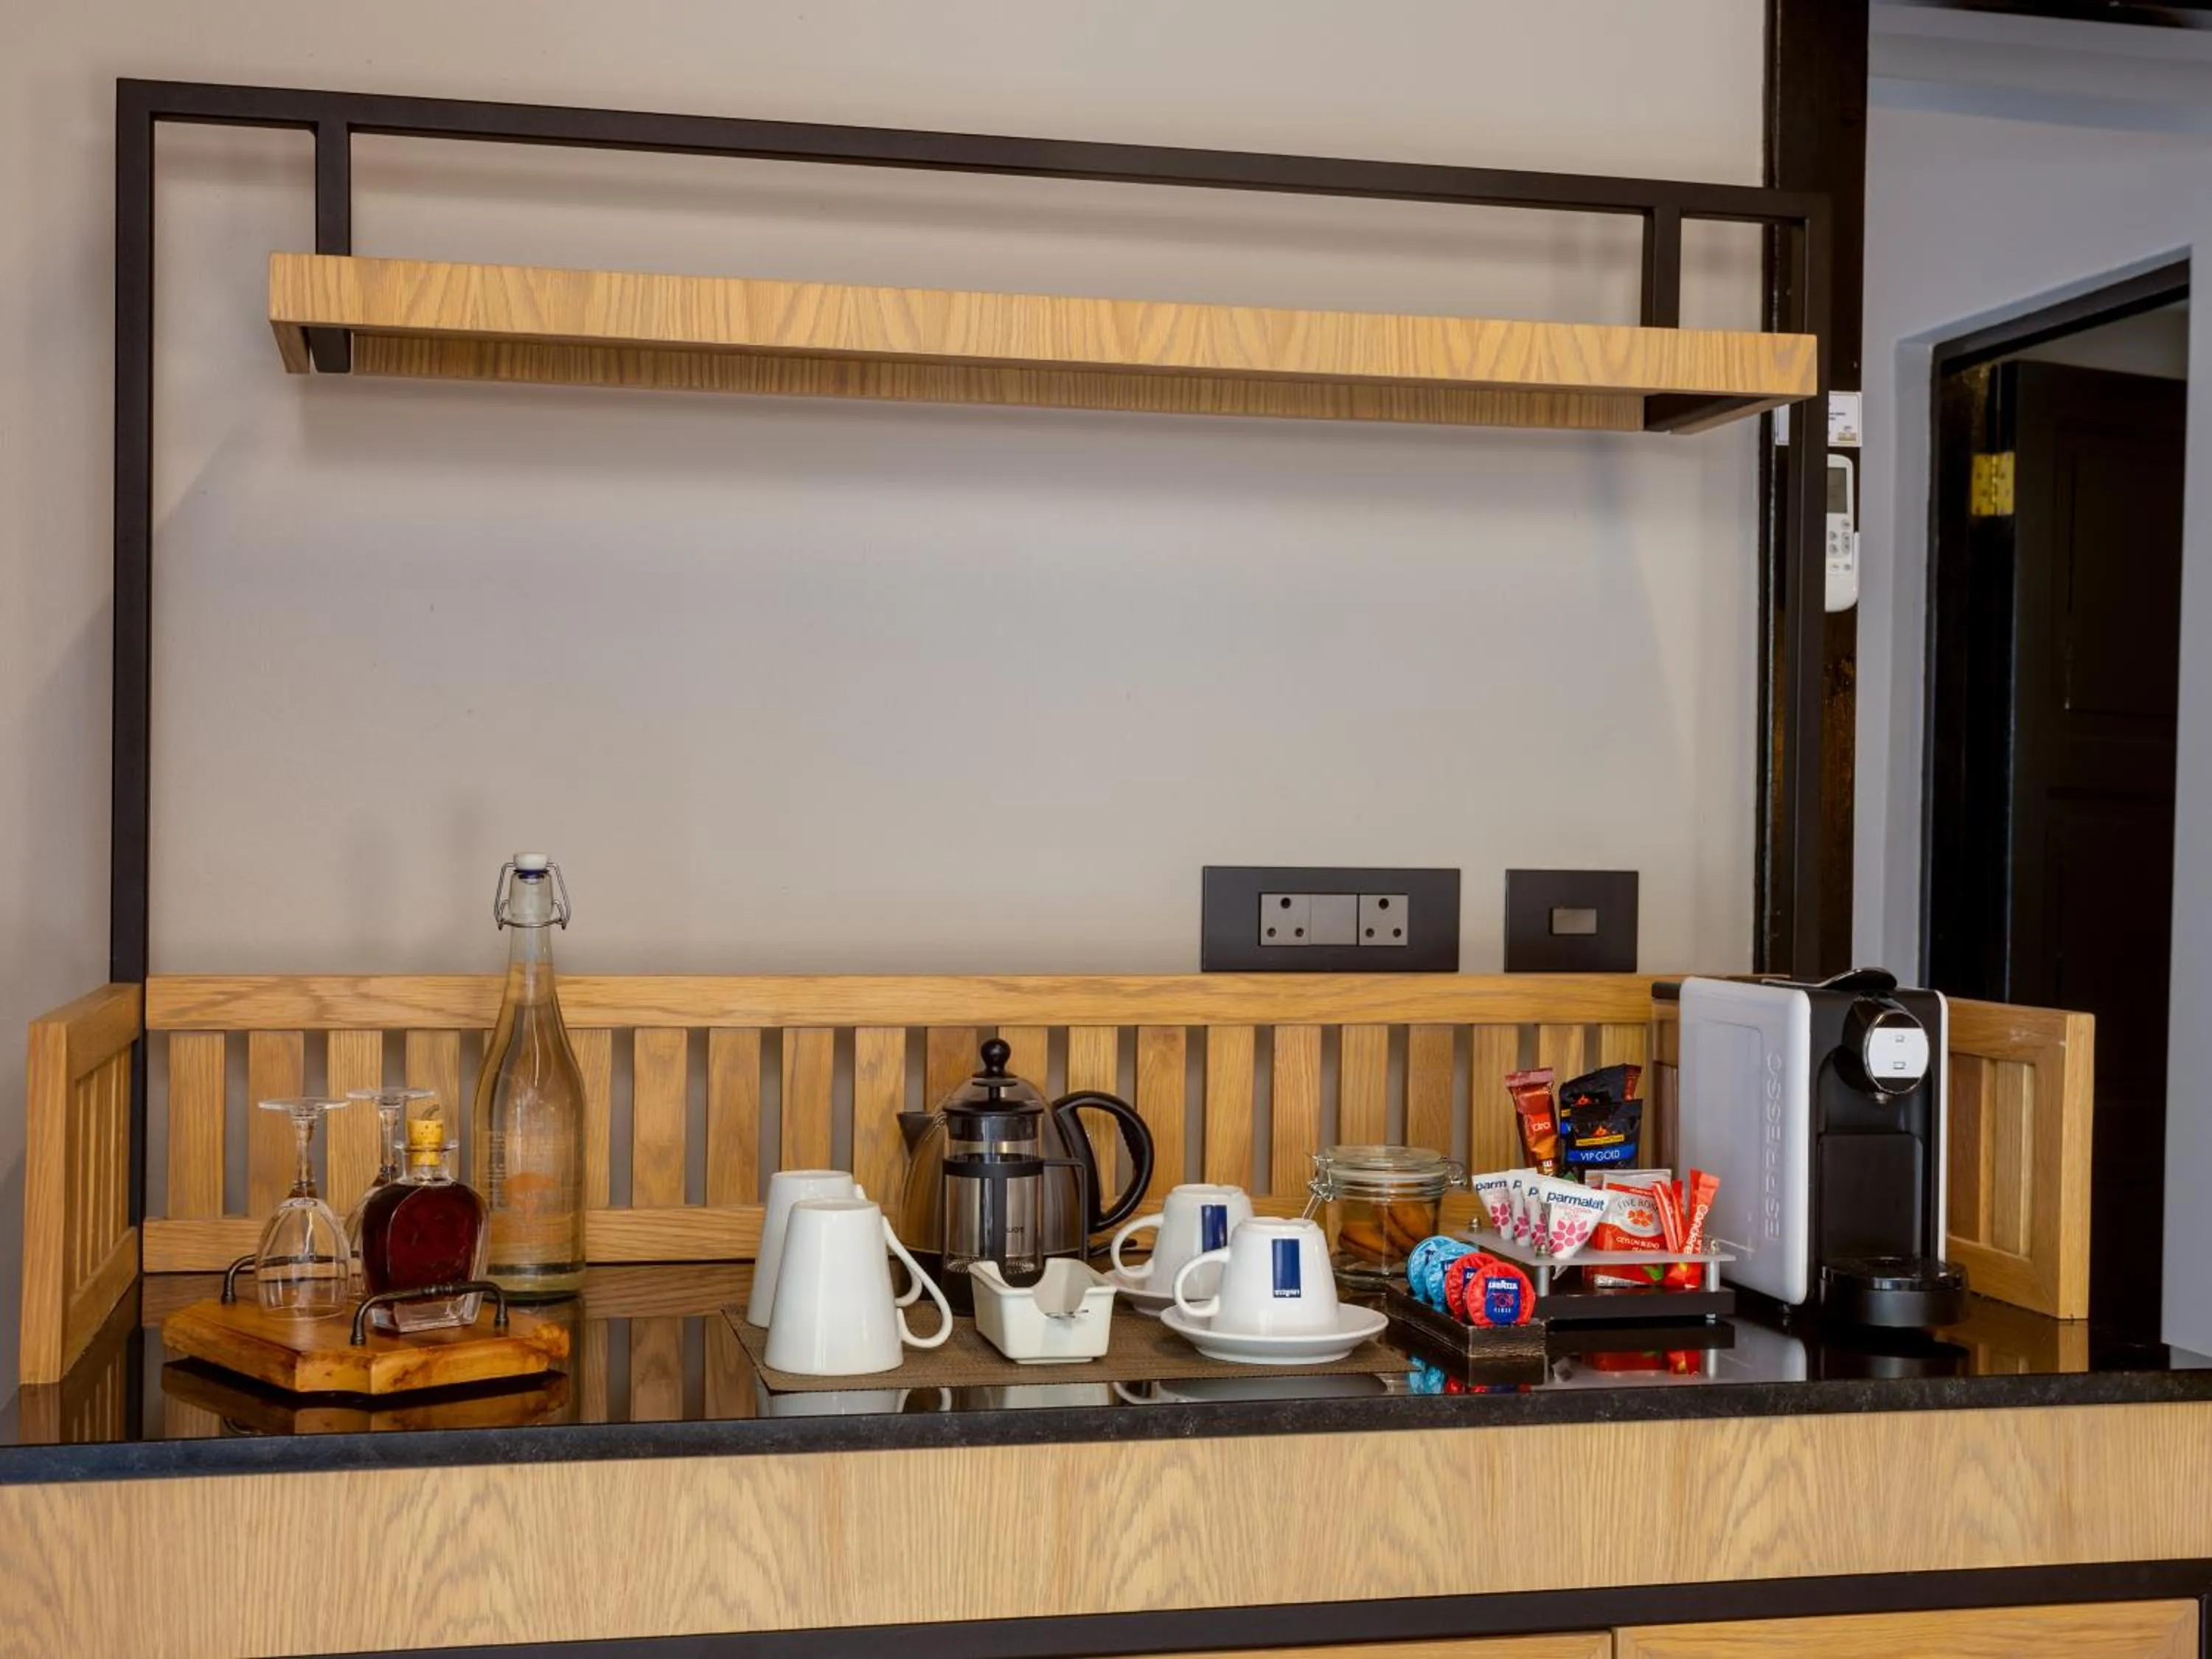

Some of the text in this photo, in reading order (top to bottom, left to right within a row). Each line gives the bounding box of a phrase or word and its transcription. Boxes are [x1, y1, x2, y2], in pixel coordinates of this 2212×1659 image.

[1764, 1050, 1783, 1240] ESPRESSO
[1475, 1180, 1508, 1191] parm
[1546, 1191, 1606, 1211] parmalat
